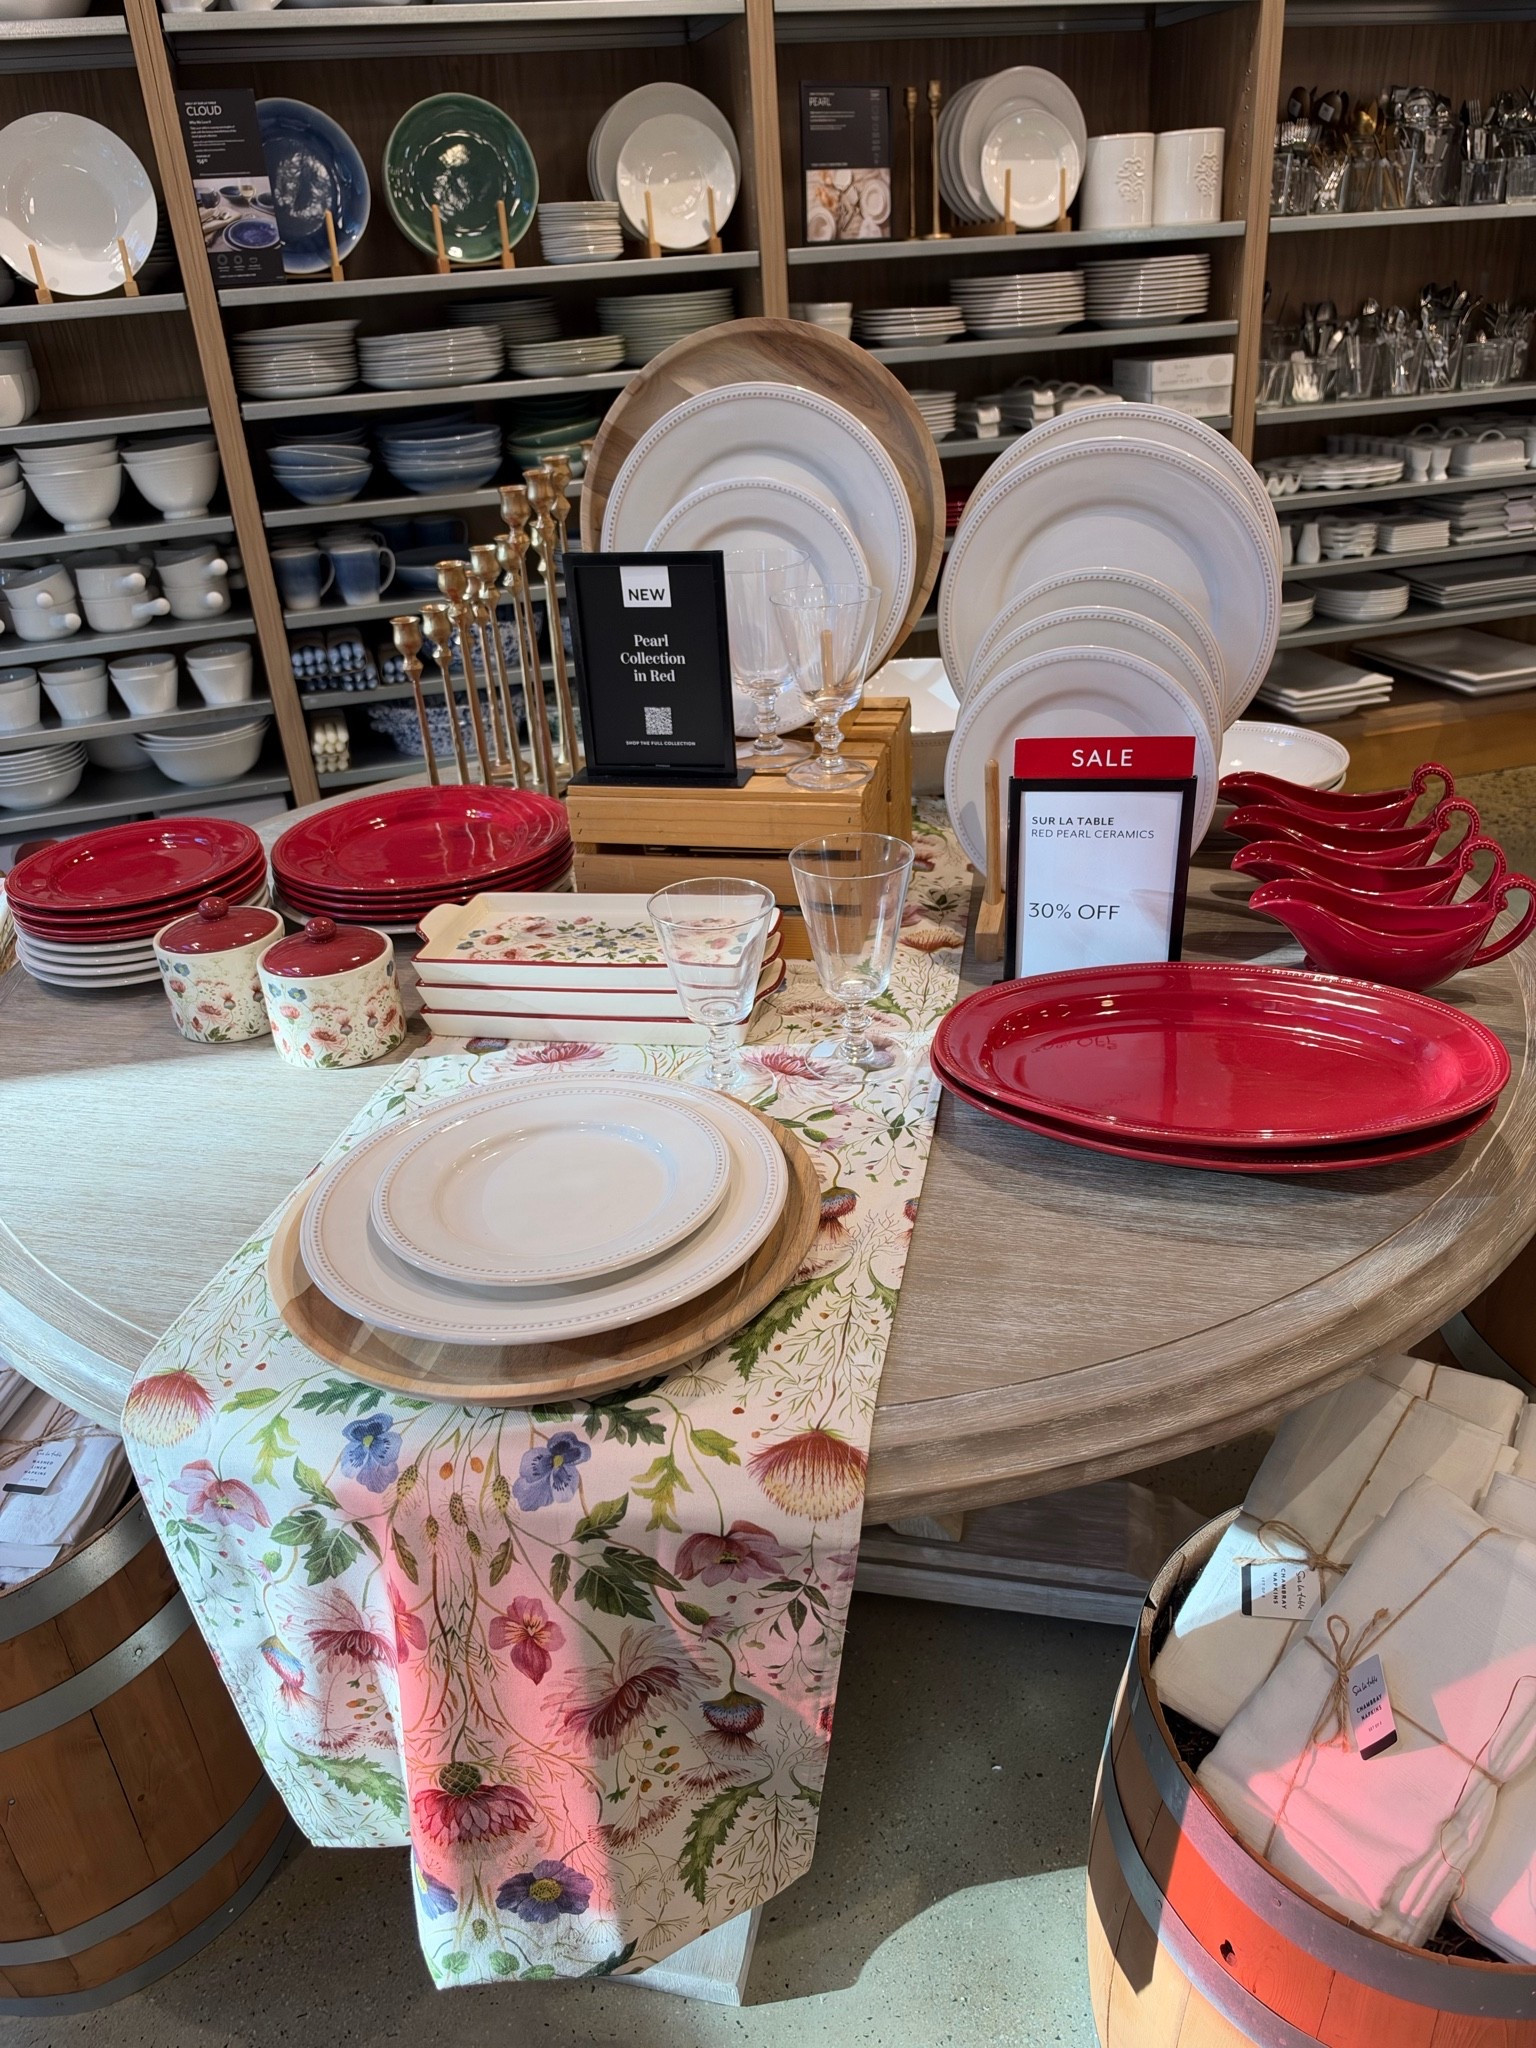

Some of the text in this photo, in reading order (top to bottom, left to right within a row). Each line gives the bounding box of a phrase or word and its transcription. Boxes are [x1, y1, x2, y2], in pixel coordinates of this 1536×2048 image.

[808, 96, 832, 107] PEARL
[186, 105, 222, 116] CLOUD
[628, 588, 665, 601] NEW
[633, 634, 669, 647] Pearl
[620, 651, 686, 665] Collection
[633, 669, 676, 682] in Red
[1071, 749, 1133, 768] SALE
[1031, 816, 1115, 826] SUR LA TABLE
[1031, 828, 1155, 839] RED PEARL CERAMICS
[1028, 902, 1120, 920] 30% OFF
[1356, 1694, 1382, 1714] CHAMBRAY
[1361, 1704, 1382, 1721] NAPKINS
